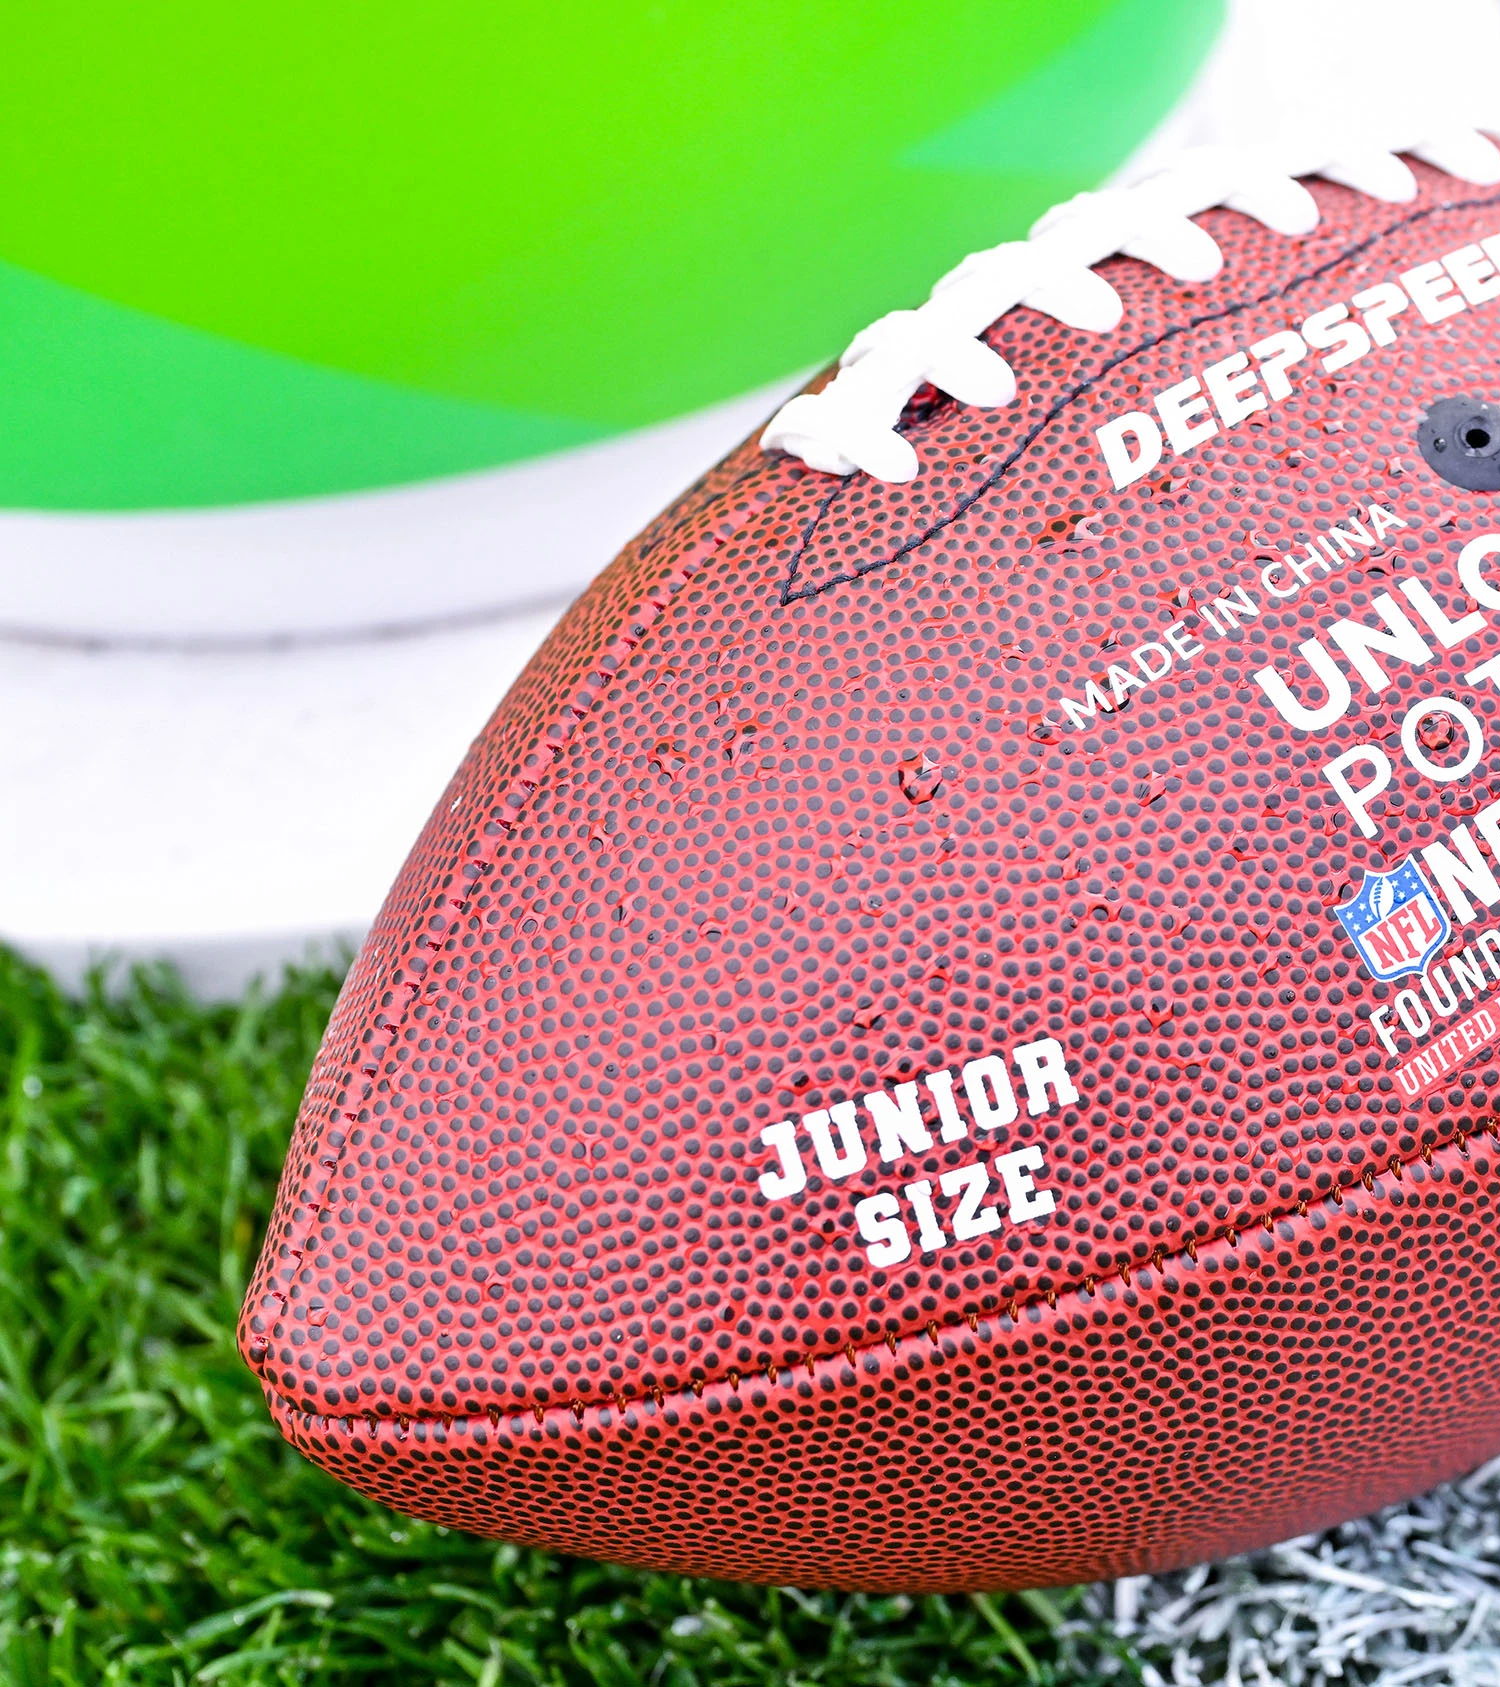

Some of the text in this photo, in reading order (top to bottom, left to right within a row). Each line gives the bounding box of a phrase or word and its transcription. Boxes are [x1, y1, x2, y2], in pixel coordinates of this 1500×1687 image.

[1059, 503, 1408, 731] MADE IN CHINA
[1363, 890, 1443, 970] NFL
[1394, 1008, 1498, 1097] UNITED
[758, 1037, 1080, 1201] JUNIOR
[854, 1145, 1057, 1268] SIZE
